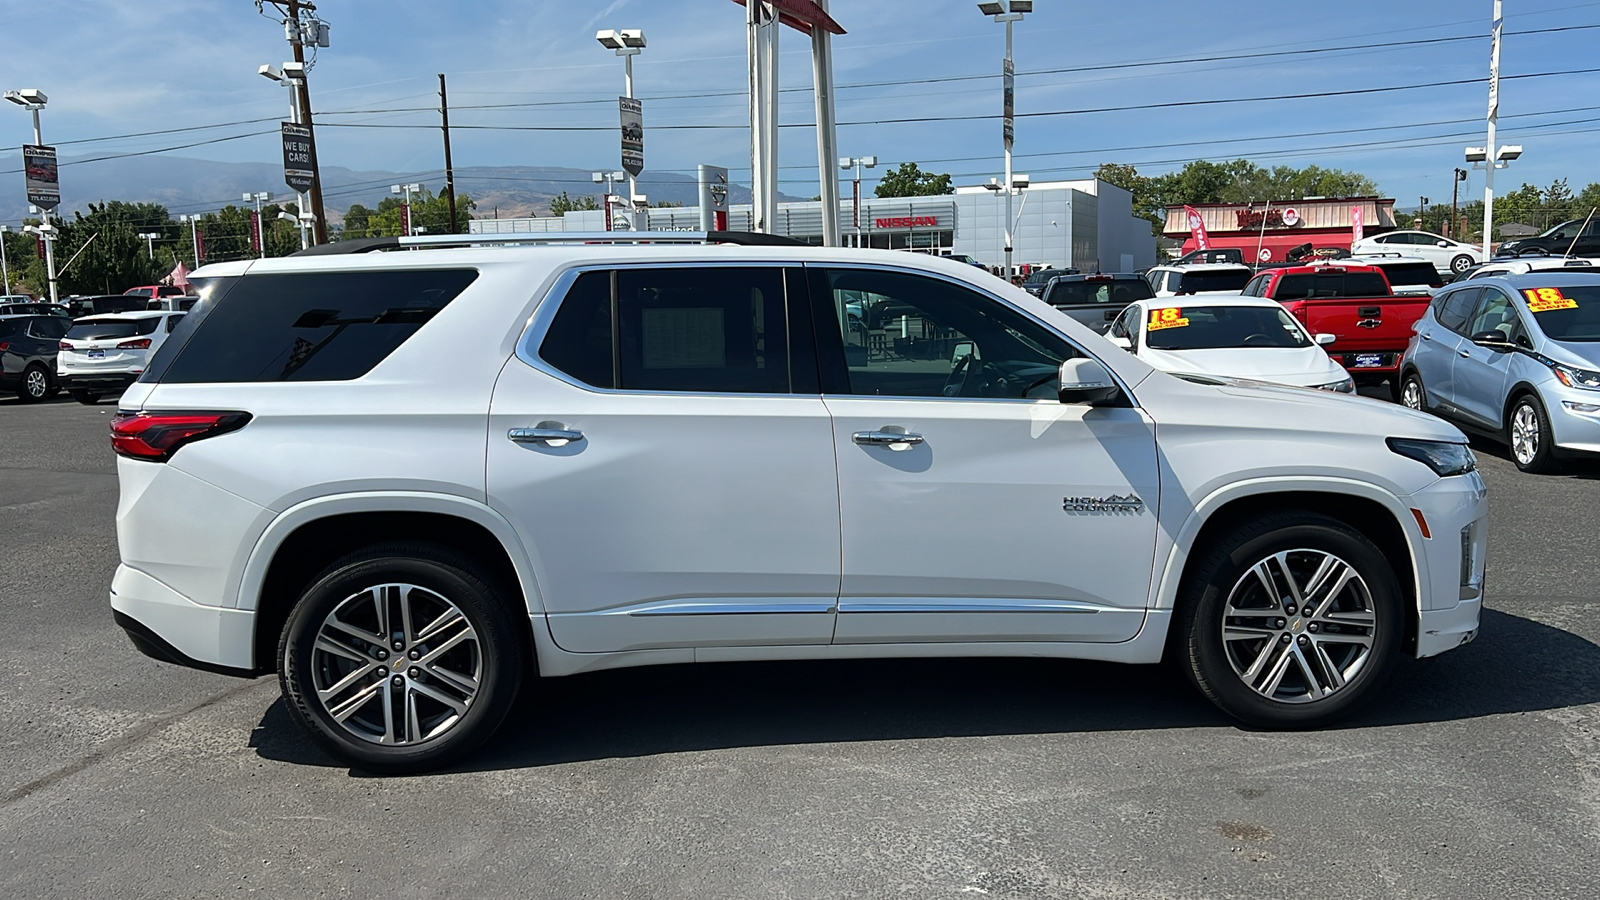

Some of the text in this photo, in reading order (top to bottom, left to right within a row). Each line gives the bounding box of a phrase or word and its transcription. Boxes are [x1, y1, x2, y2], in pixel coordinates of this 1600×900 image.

[284, 141, 310, 153] WE BUY
[288, 153, 309, 163] CARS!
[876, 216, 936, 228] NISSAN
[1526, 287, 1562, 304] 18
[1151, 308, 1179, 323] 18
[1063, 496, 1103, 504] HIGH
[1063, 504, 1141, 512] COUNTRY
